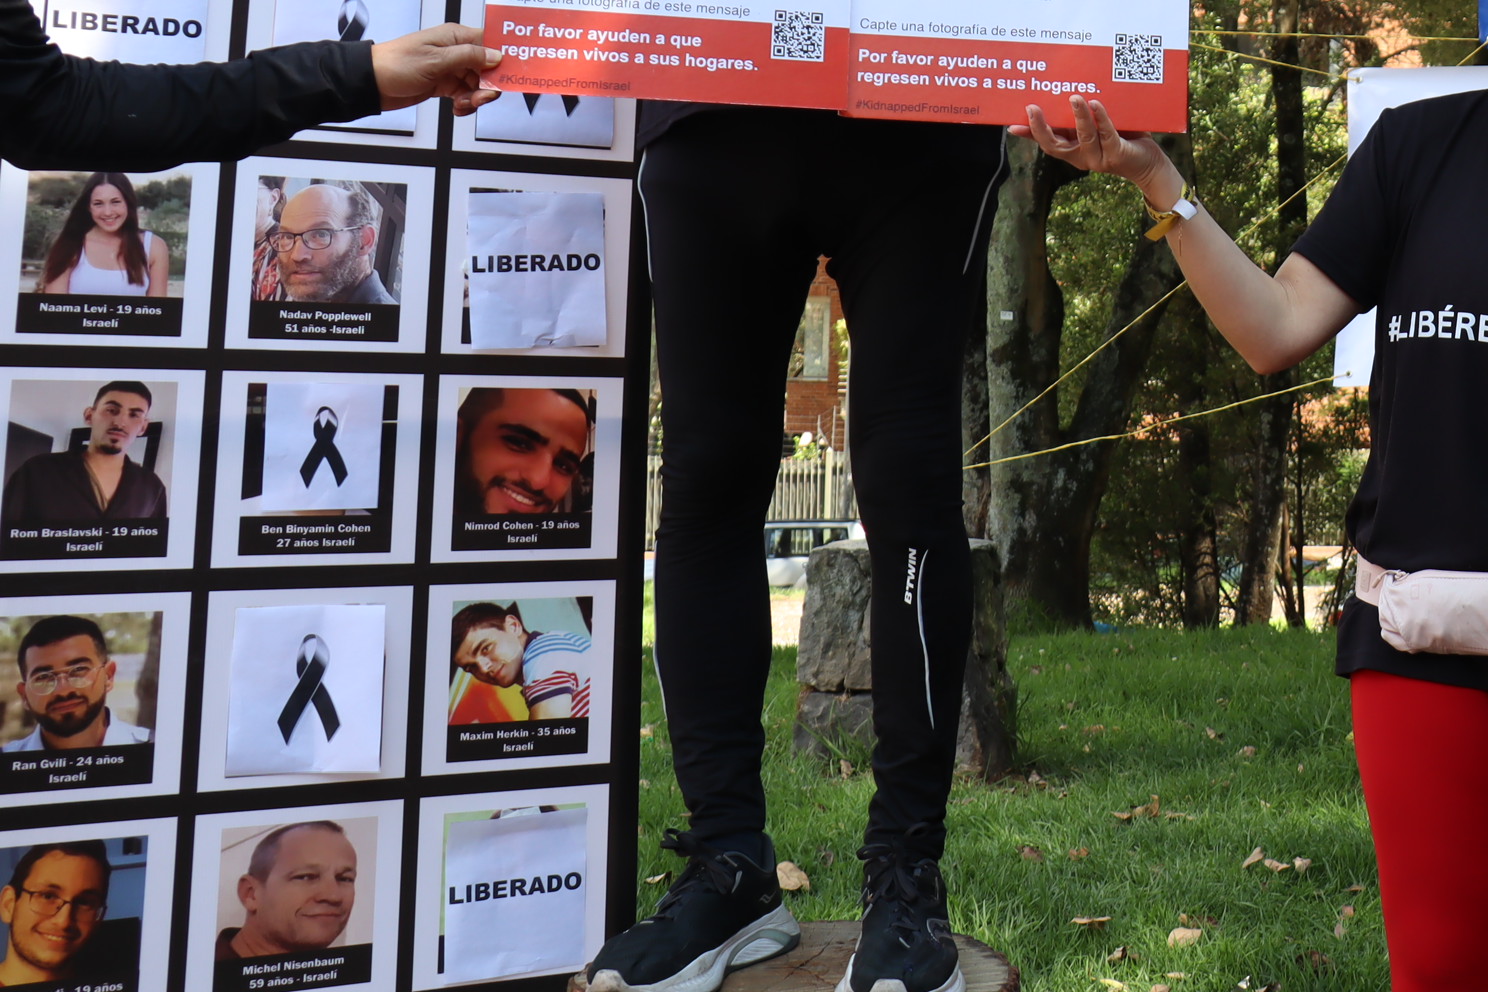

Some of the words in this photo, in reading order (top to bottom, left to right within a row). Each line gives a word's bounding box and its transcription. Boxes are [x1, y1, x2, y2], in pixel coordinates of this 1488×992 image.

[644, 0, 660, 10] de
[665, 2, 692, 12] este
[696, 5, 750, 18] mensaje
[52, 9, 202, 39] LIBERADO
[860, 18, 897, 32] Capte
[902, 23, 924, 32] una
[929, 22, 987, 36] fotografía
[991, 25, 1006, 36] de
[1011, 28, 1036, 37] este
[1041, 30, 1092, 43] mensaje
[503, 21, 534, 36] Por
[538, 24, 583, 39] favor
[587, 29, 650, 45] ayuden
[655, 34, 665, 44] a
[670, 35, 701, 49] que
[499, 46, 578, 60] regresen
[583, 47, 629, 62] vivos
[634, 53, 644, 63] a
[649, 54, 679, 66] sus
[685, 53, 757, 71] hogares.
[859, 49, 887, 63] Por
[892, 51, 934, 65] favor
[938, 55, 997, 70] ayuden
[1002, 59, 1011, 69] a
[1017, 60, 1046, 73] que
[498, 73, 631, 92] #KidnappedFromIsrael
[858, 72, 929, 86] regresen
[935, 73, 977, 87] vivos
[983, 78, 991, 88] a
[997, 79, 1025, 90] sus
[1031, 77, 1100, 94] hogares.
[855, 100, 980, 115] #KidnappedFromIsrael
[472, 252, 601, 274] LIBERADO
[40, 303, 81, 312] Naama
[84, 304, 107, 313] Levi
[116, 305, 132, 314] 19
[135, 306, 162, 315] años
[280, 310, 312, 319] Nadav
[315, 311, 371, 322] Popplewell
[285, 324, 299, 332] 51
[302, 324, 327, 333] años
[10, 529, 38, 538] Rom
[41, 527, 102, 537] Braslavski
[112, 527, 128, 536] 19
[131, 527, 158, 536] años
[262, 525, 283, 534] Ben
[286, 524, 334, 535] Binyamin
[338, 524, 371, 533] Cohen
[465, 522, 500, 530] Nimrod
[503, 521, 533, 530] Cohen
[542, 521, 554, 529] 19
[557, 520, 580, 529] años
[276, 539, 291, 547] 27
[294, 538, 319, 547] años
[460, 731, 493, 741] Maxim
[497, 729, 529, 739] Herkin
[537, 727, 550, 736] 35
[553, 726, 576, 735] años
[12, 761, 36, 771] Ran
[40, 758, 66, 769] Gvili
[76, 756, 92, 766] 24
[96, 755, 124, 765] años
[448, 871, 583, 905] LIBERADO
[243, 963, 281, 975] Michel
[284, 957, 344, 970] Nisenbaum
[249, 979, 264, 989] 59
[267, 977, 294, 987] años
